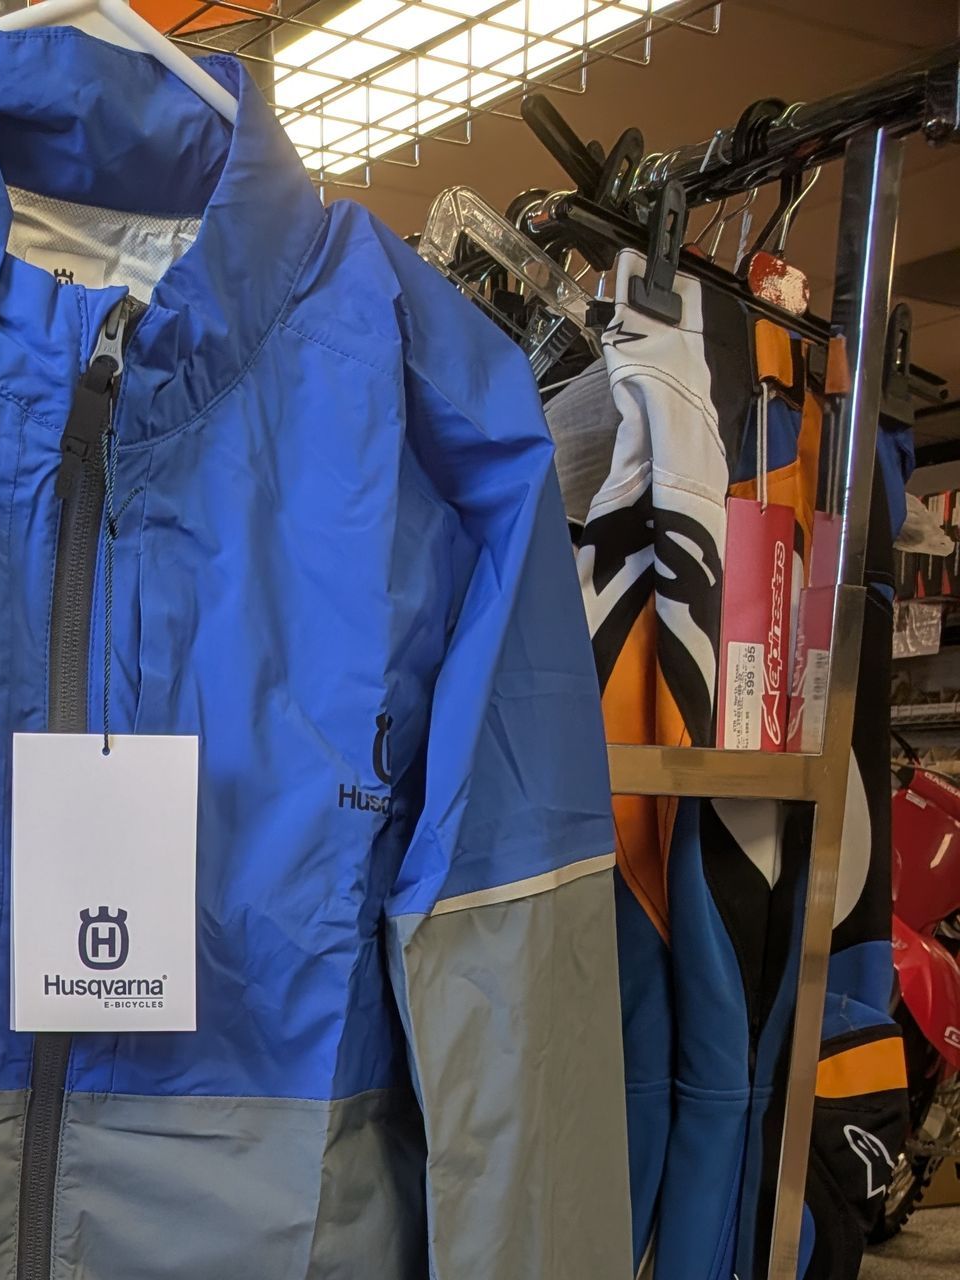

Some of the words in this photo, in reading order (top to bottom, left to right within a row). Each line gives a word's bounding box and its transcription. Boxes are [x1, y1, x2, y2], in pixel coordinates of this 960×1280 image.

[745, 645, 755, 695] $99.95
[44, 974, 164, 1000] Husqvarna
[104, 1001, 164, 1009] E-BICYCLES
